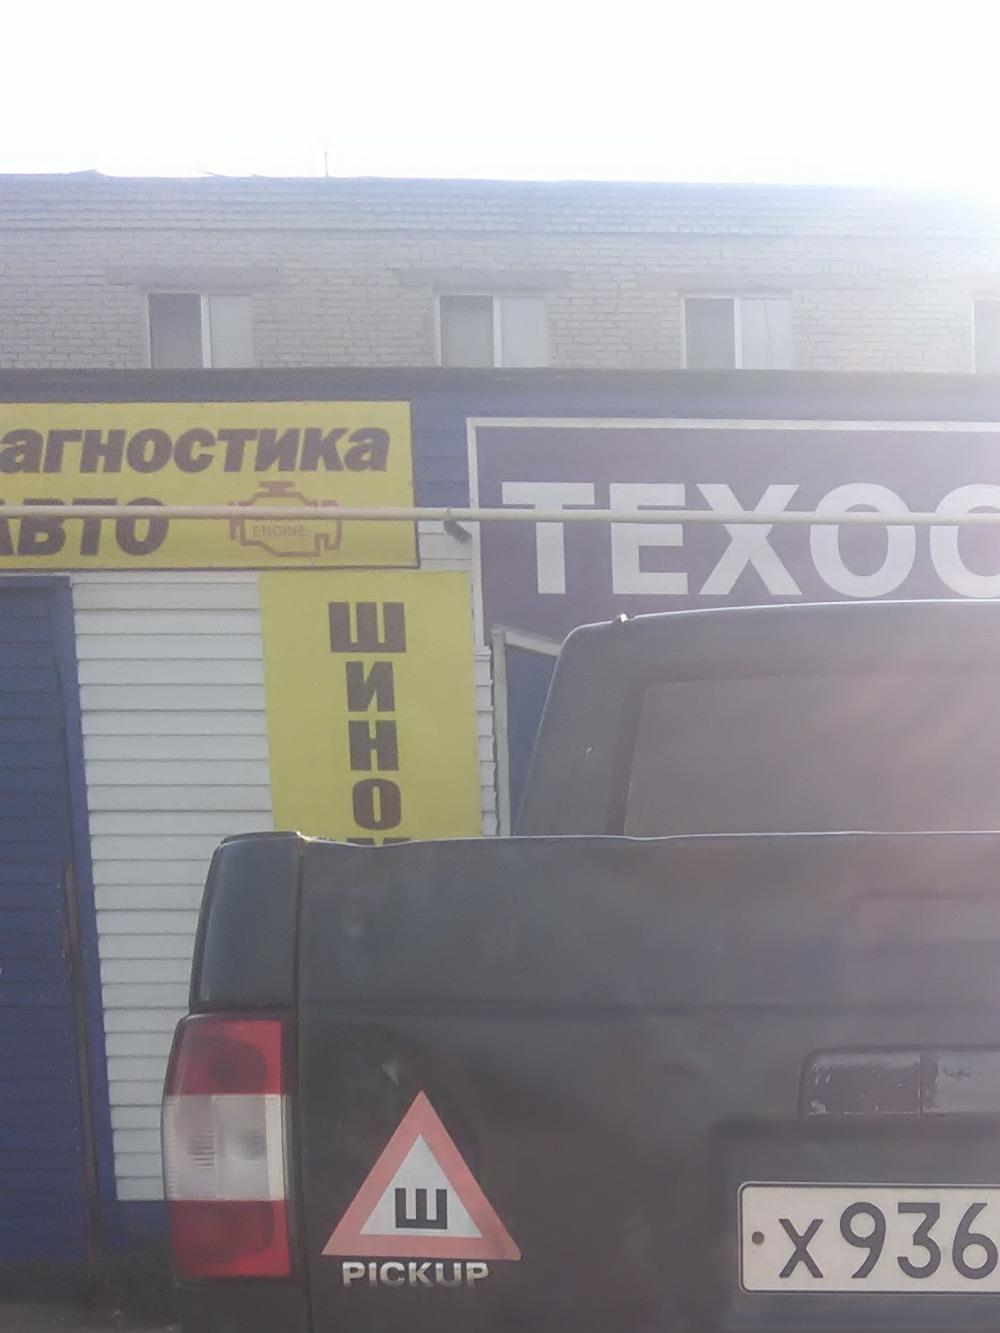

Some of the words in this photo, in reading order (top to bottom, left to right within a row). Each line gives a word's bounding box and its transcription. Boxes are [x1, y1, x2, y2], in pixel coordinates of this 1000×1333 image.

[252, 525, 308, 537] ENGINE
[328, 602, 411, 847] ШИНО
[394, 1187, 448, 1230] Ш
[342, 1261, 490, 1287] PICKUP
